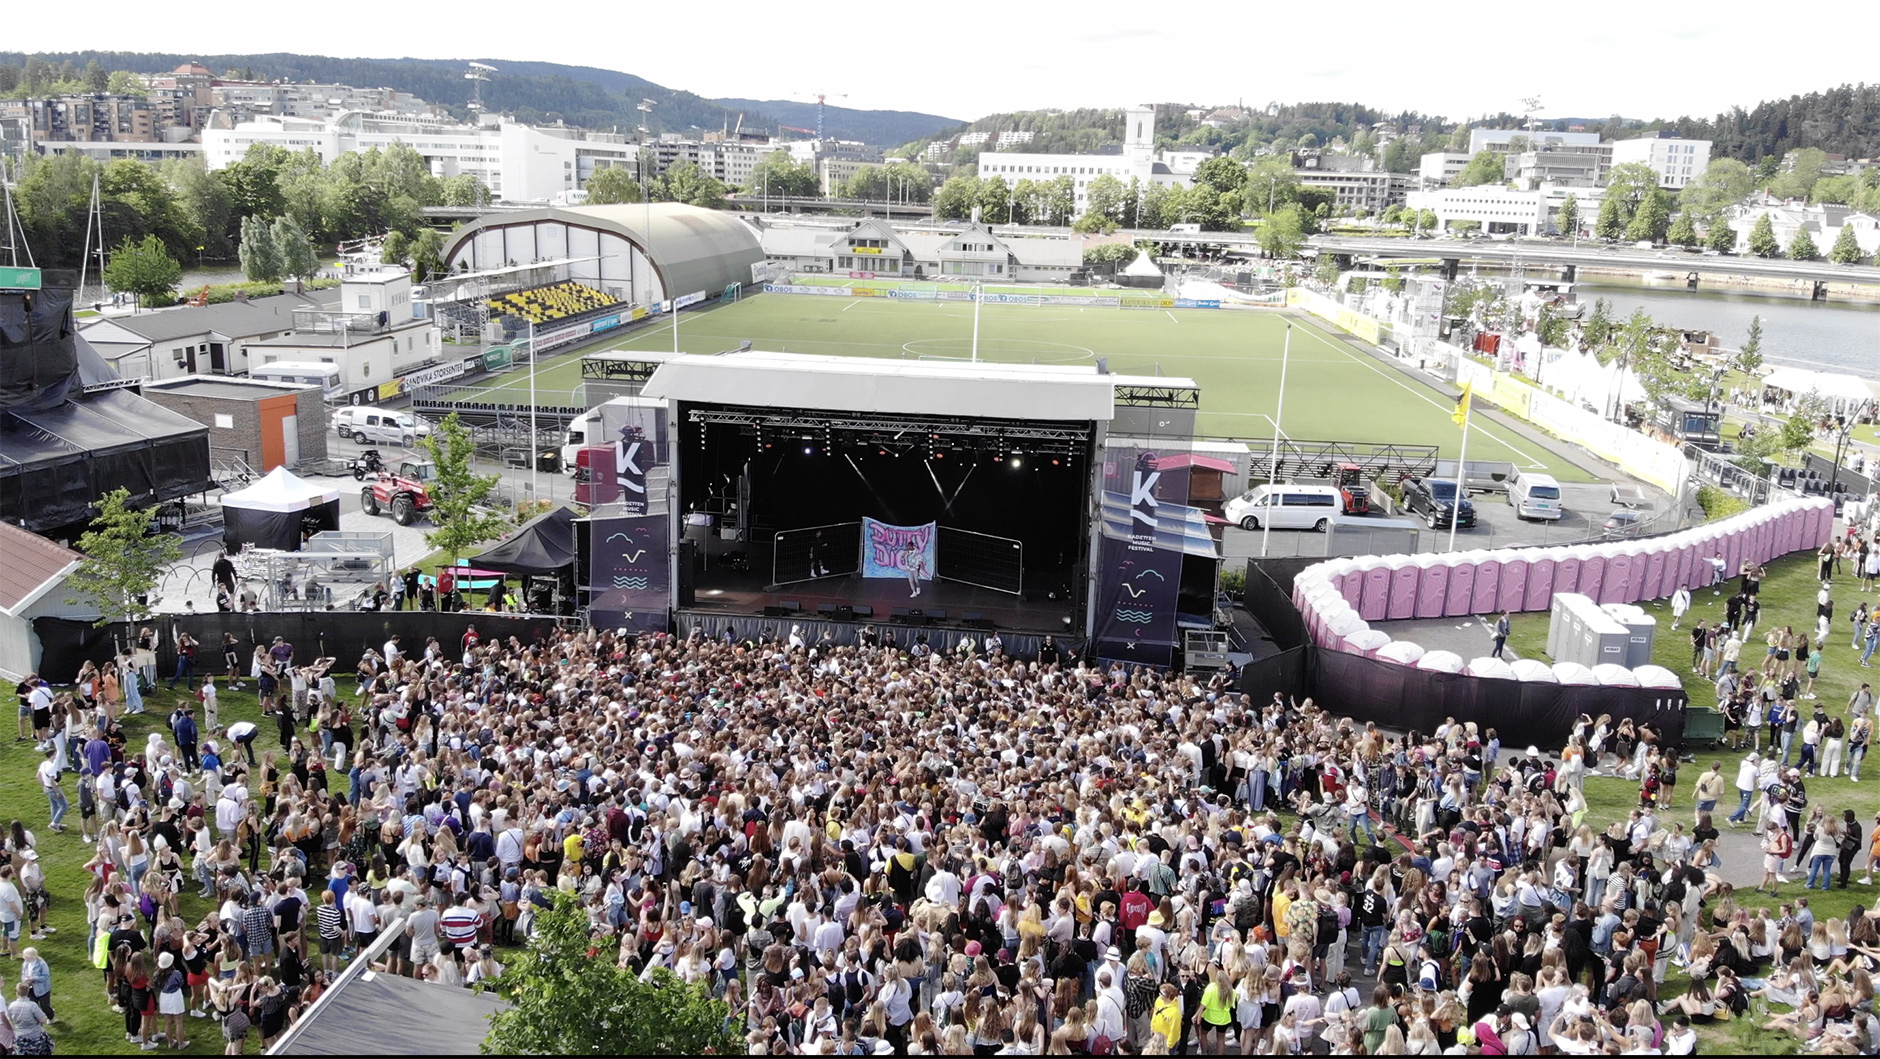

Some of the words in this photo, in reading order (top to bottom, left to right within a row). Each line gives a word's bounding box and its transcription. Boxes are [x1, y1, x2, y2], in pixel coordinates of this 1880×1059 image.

[405, 371, 432, 388] SANDVIKA
[433, 362, 463, 380] STORSENTER
[616, 441, 643, 475] K
[1131, 471, 1161, 507] K
